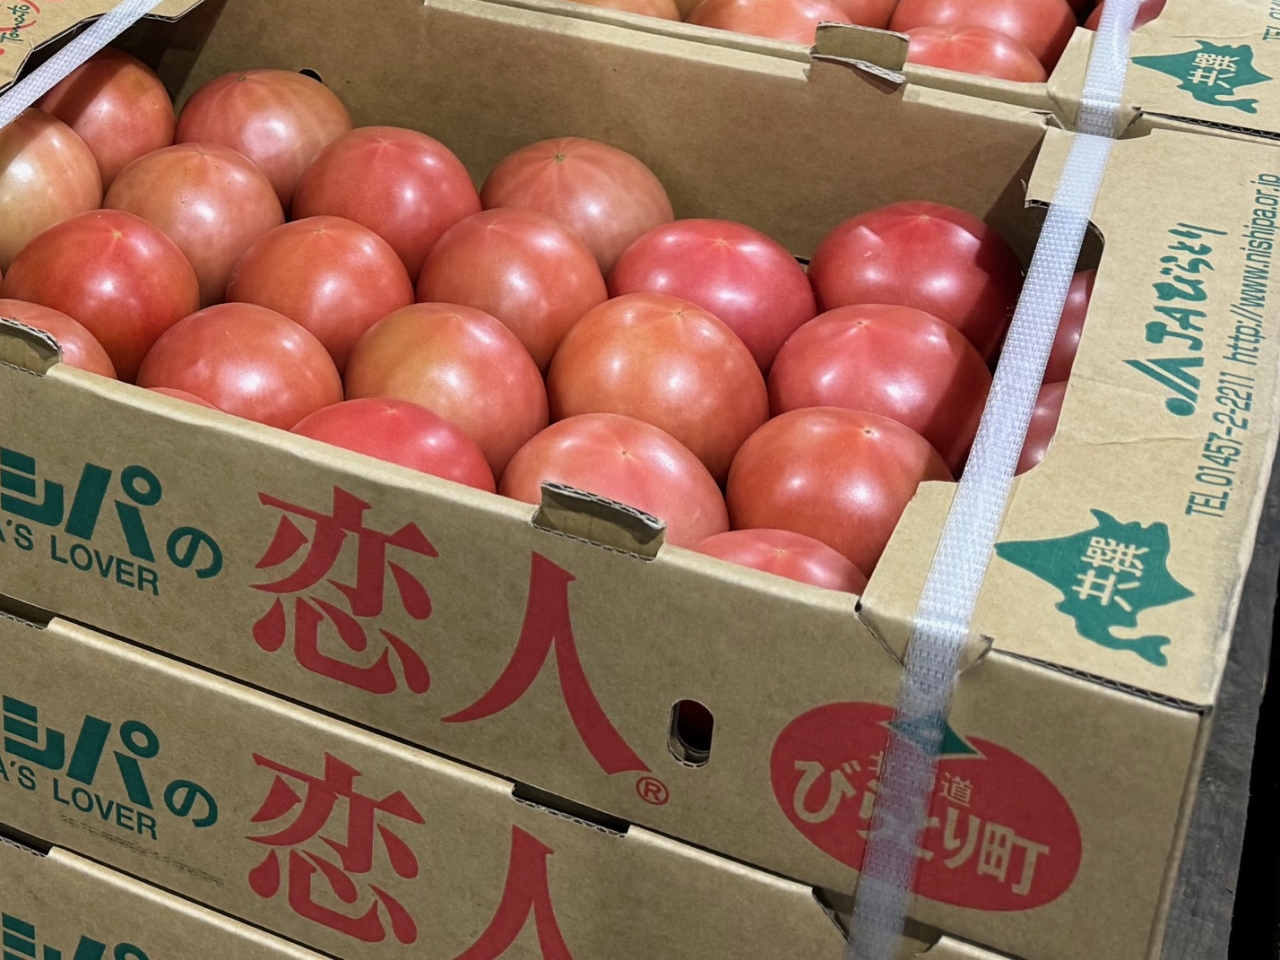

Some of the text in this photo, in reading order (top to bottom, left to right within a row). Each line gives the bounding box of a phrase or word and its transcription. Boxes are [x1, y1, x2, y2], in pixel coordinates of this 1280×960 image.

[50, 533, 161, 597] LOVER
[254, 488, 647, 773] 恋人
[53, 777, 158, 841] LOVER
[250, 755, 572, 960] 恋人
